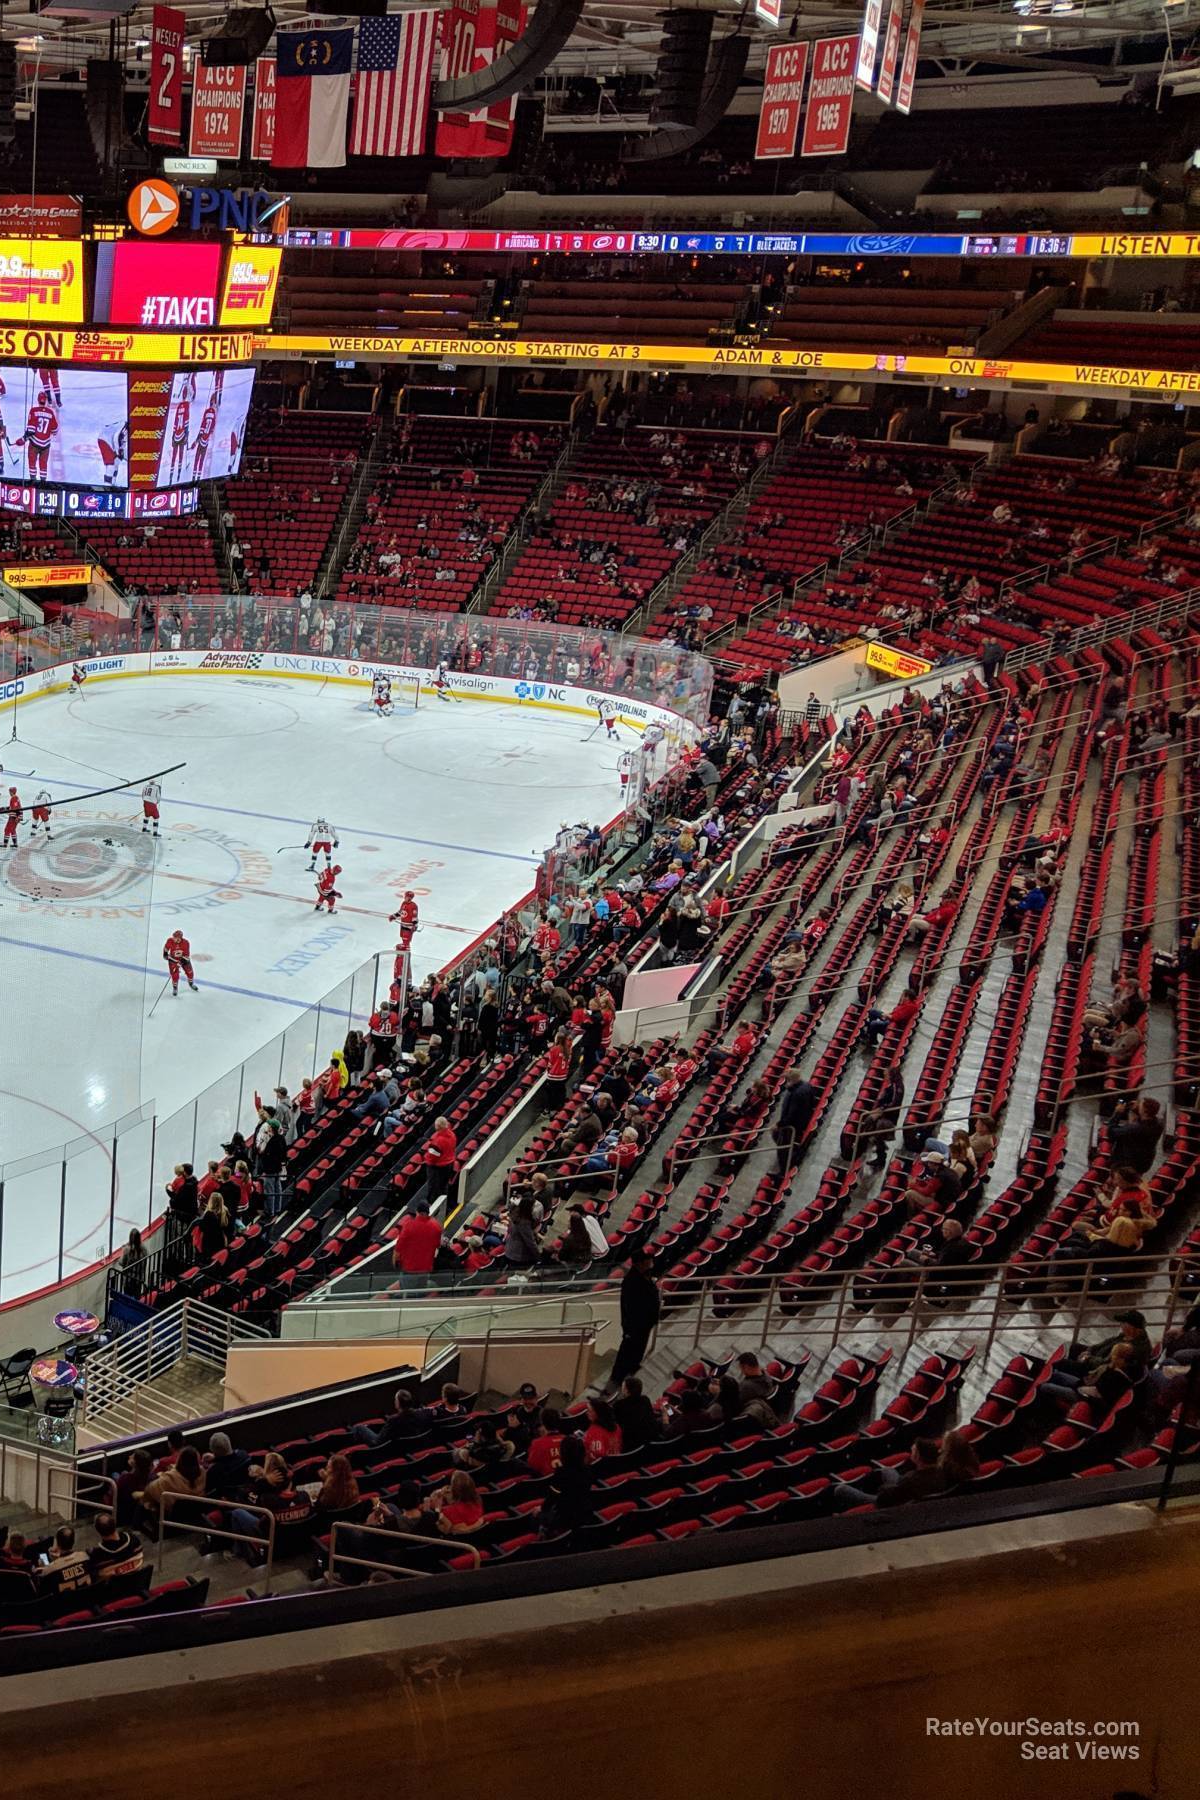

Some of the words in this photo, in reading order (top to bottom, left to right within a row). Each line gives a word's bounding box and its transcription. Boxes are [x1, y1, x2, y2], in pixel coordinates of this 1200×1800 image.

[155, 28, 181, 48] WESLEY
[451, 19, 476, 80] 10
[821, 42, 850, 72] ACC
[774, 50, 799, 77] ACC
[158, 53, 176, 108] 2
[205, 65, 234, 86] ACC
[764, 80, 800, 104] CHAMPIONS
[812, 75, 853, 98] CHAMPIONS
[196, 90, 241, 108] CHAMPIONS
[204, 112, 229, 134] 1974
[768, 108, 789, 134] 1970
[816, 102, 840, 132] 1965
[49, 207, 80, 218] GAME
[191, 187, 272, 232] PNC
[616, 236, 625, 248] 0
[638, 236, 659, 247] 8:30
[670, 236, 678, 250] 0
[757, 240, 772, 250] BLUE
[773, 240, 797, 250] JACKETS
[1040, 238, 1060, 254] 6:36
[1100, 236, 1172, 257] LISTEN
[1185, 237, 1200, 254] T
[142, 296, 214, 325] #TAKE
[24, 331, 64, 356] ON
[74, 332, 100, 344] 99.9
[180, 336, 240, 360] LISTEN
[330, 338, 404, 352] WEEKDAY
[412, 340, 516, 355] AFTERNOONS
[526, 343, 599, 358] STARTING
[609, 345, 626, 358] AT
[632, 346, 640, 358] 3
[714, 350, 762, 364] ADAM
[772, 351, 782, 364] &
[792, 352, 822, 366] JOE
[950, 360, 976, 374] ON
[1076, 368, 1151, 386] WEEKDAY
[37, 418, 50, 434] 37
[22, 488, 30, 505] 0
[40, 490, 58, 507] 8:30
[69, 494, 79, 508] 0
[8, 574, 26, 583] 99.9
[50, 568, 86, 580] ESPN
[99, 659, 124, 671] LIGHT
[204, 652, 246, 662] Advance
[221, 661, 244, 669] Parts
[273, 656, 307, 670] UNC
[311, 660, 342, 674] REX
[548, 690, 566, 701] NC
[613, 701, 647, 719] AROLINAS
